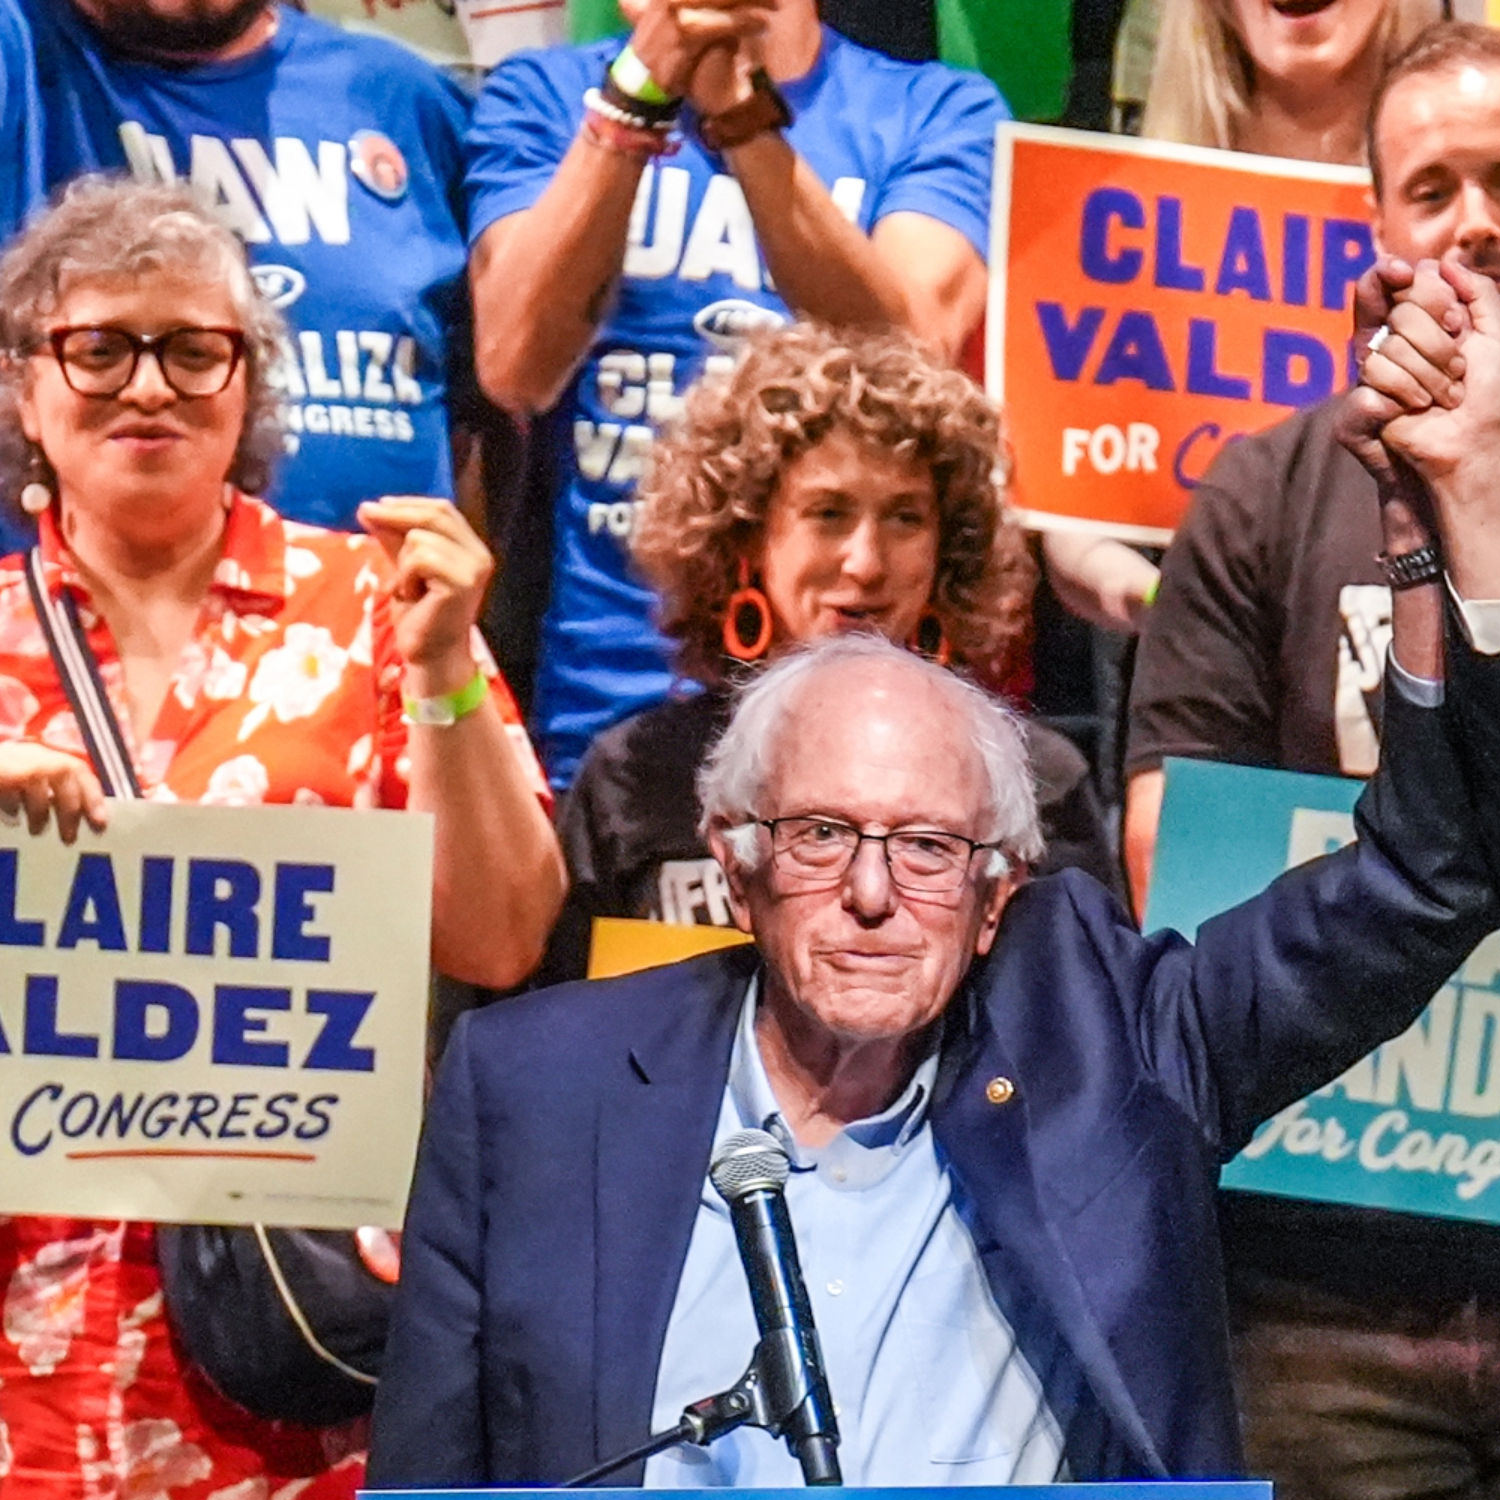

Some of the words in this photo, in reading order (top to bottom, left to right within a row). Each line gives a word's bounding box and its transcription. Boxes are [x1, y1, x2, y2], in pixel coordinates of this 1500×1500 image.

[621, 163, 866, 291] UA
[1079, 187, 1377, 311] CLAIR
[1035, 300, 1360, 410] VALD
[277, 403, 415, 443] NGRESS
[1062, 422, 1160, 476] FOR
[0, 847, 336, 962] LAIRE
[0, 974, 377, 1072] LDEZ
